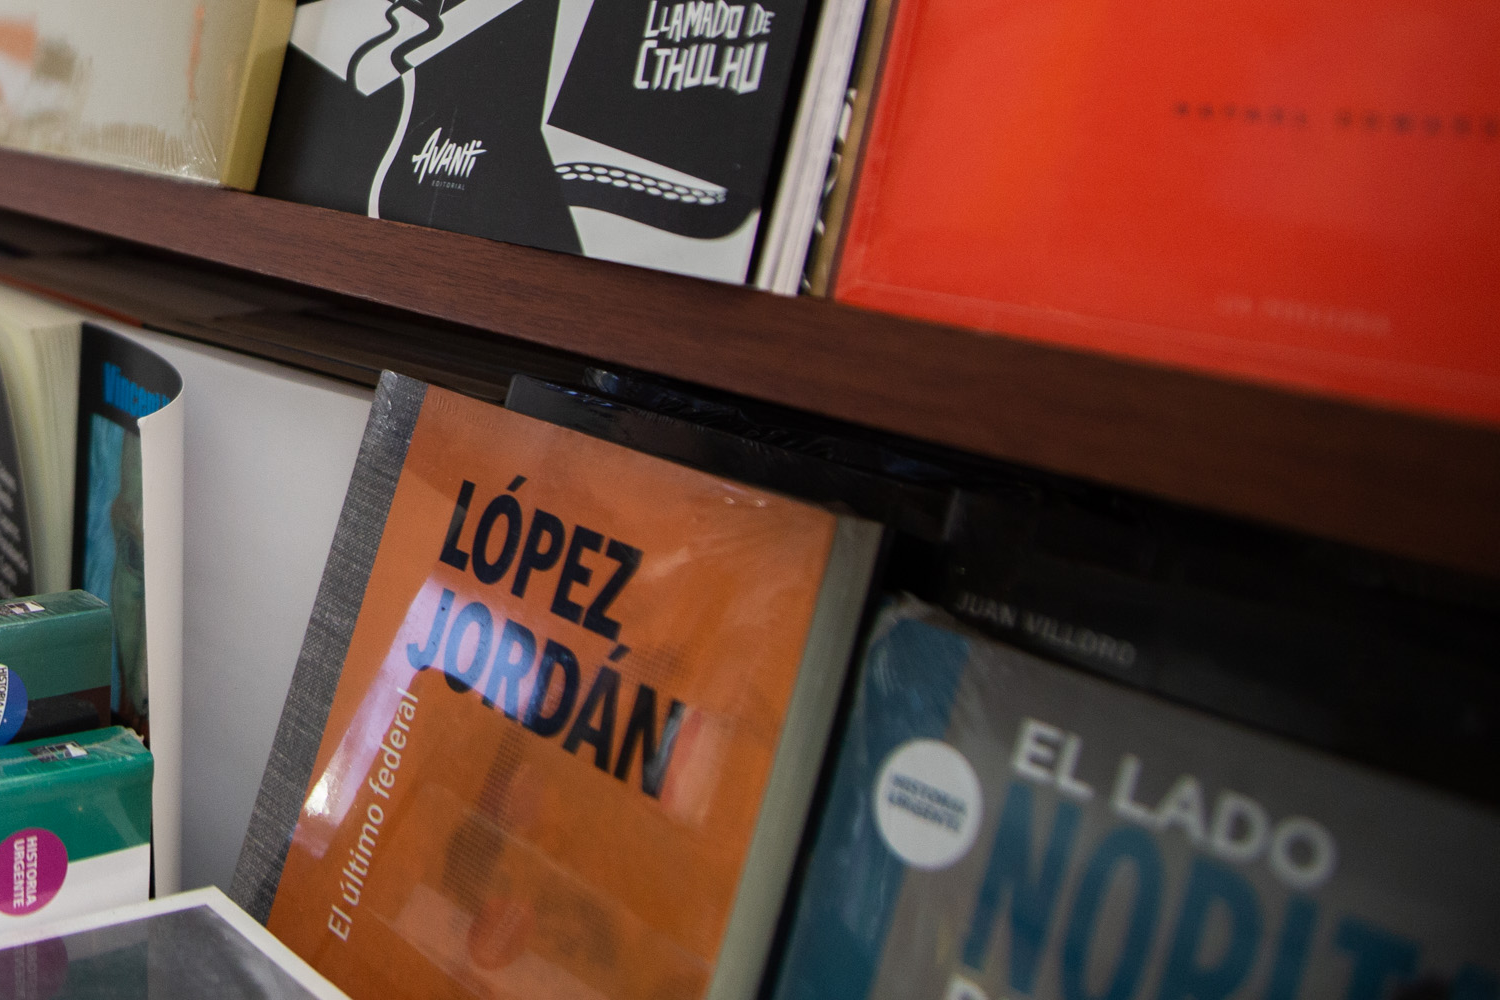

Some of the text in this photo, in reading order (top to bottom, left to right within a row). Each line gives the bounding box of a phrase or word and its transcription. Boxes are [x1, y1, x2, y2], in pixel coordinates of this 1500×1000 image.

[643, 0, 775, 42] LLAMADO DE
[633, 39, 768, 94] CTHULHU
[431, 179, 466, 191] EDITORIAL
[439, 475, 644, 642] LÓPEZ
[407, 588, 686, 799] JORDÁN
[328, 687, 420, 942] El último federal
[1012, 717, 1338, 889] EL LADO
[13, 839, 25, 909] URGENTE
[26, 836, 38, 907] HISTORIA
